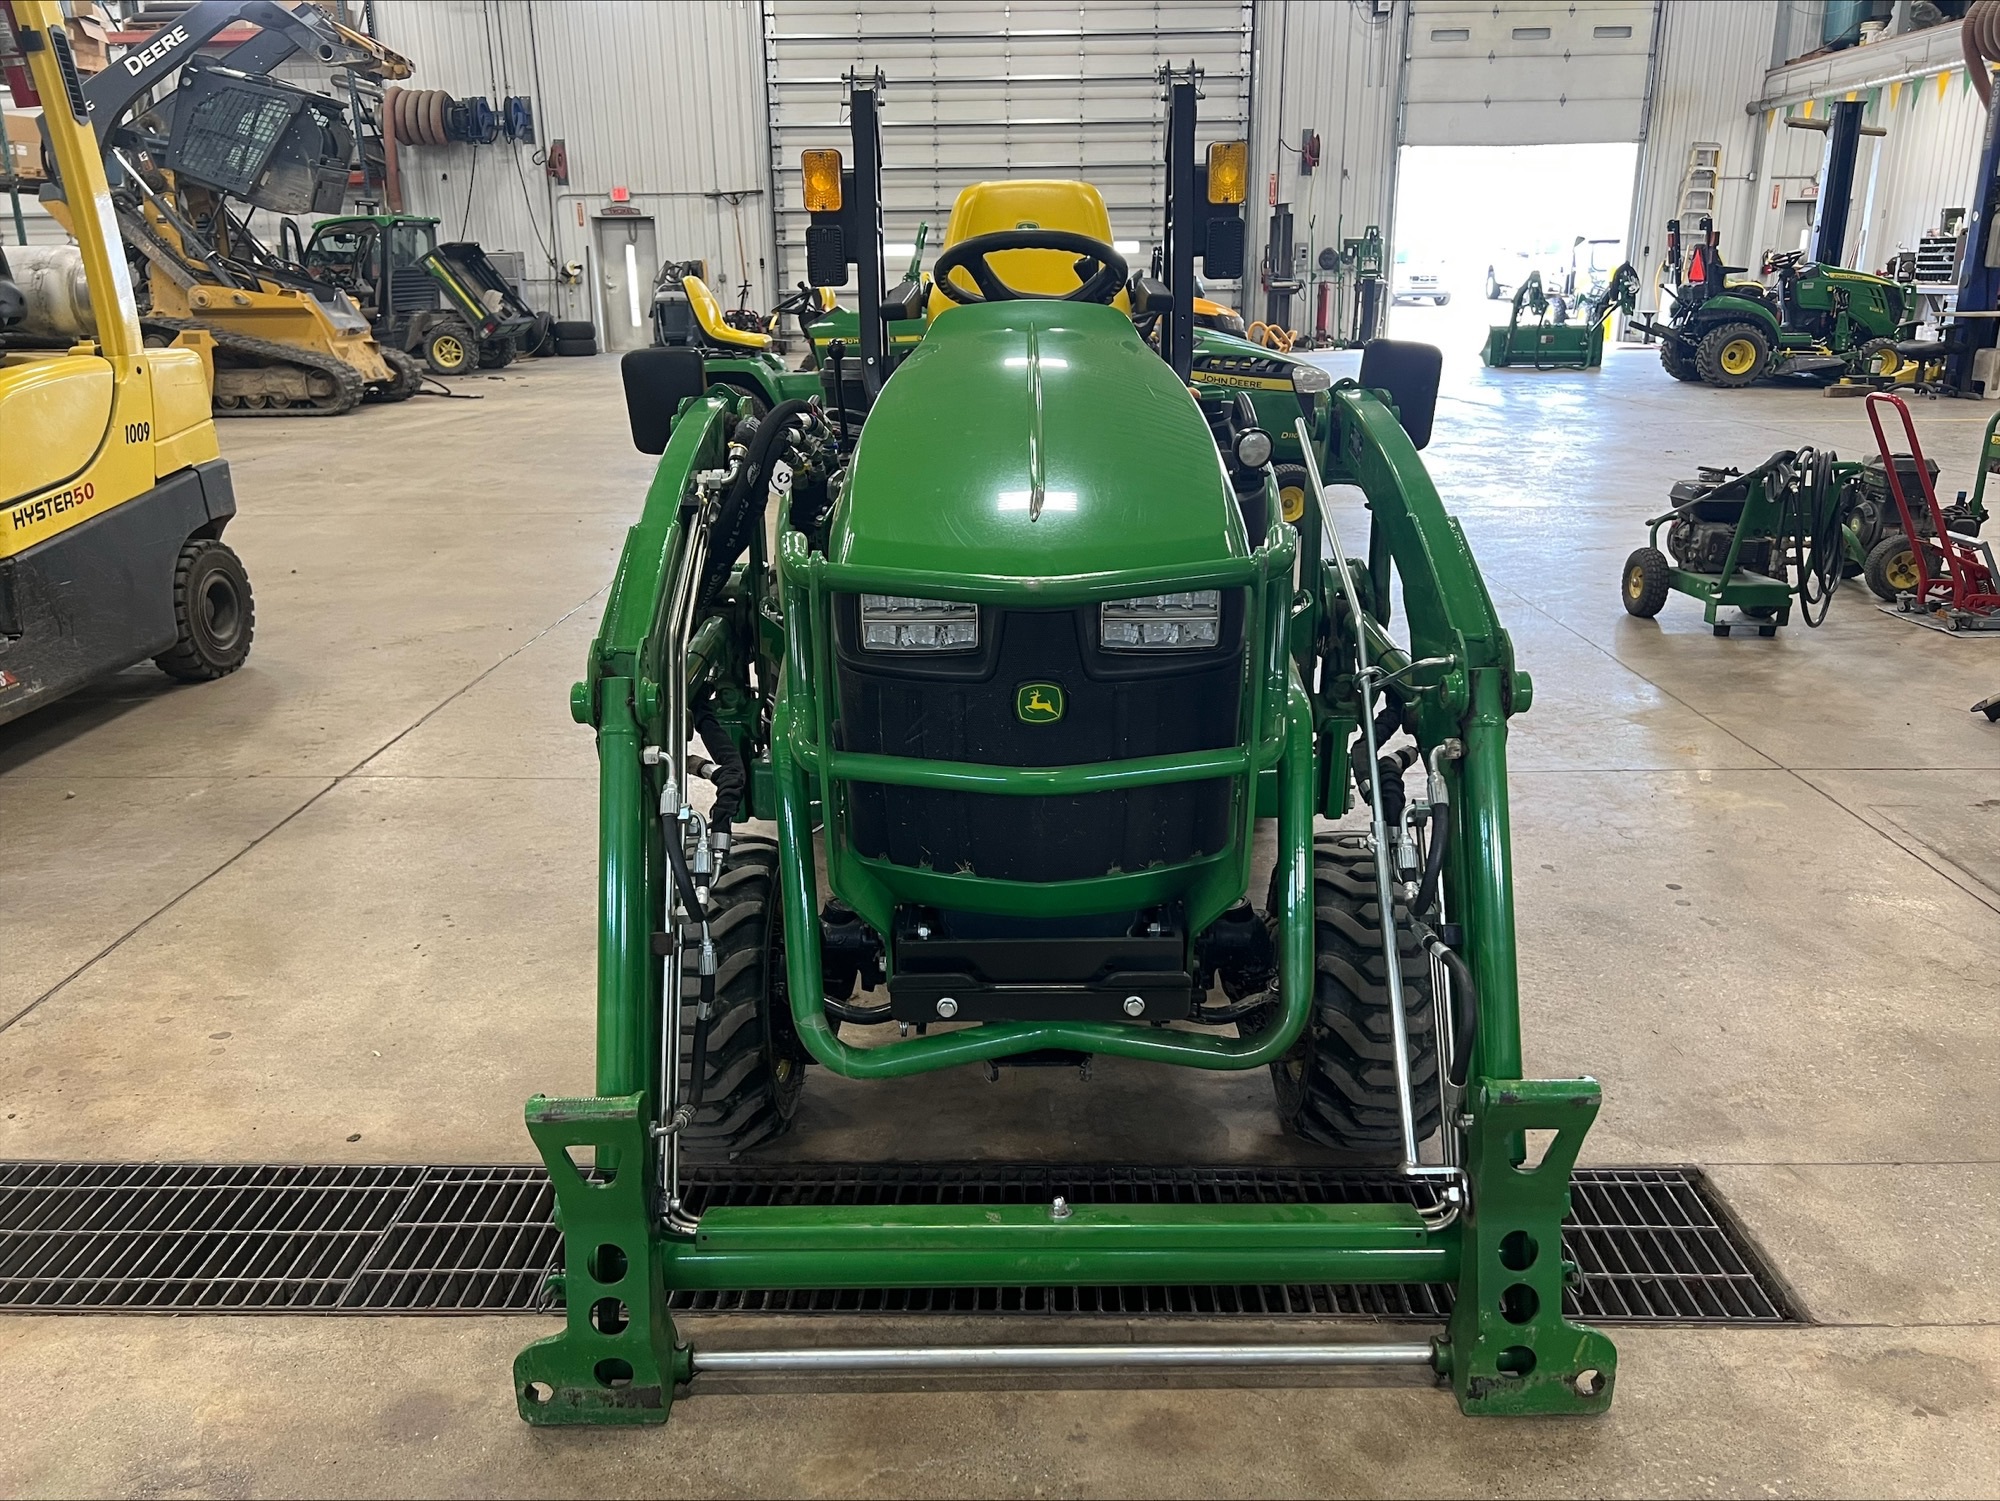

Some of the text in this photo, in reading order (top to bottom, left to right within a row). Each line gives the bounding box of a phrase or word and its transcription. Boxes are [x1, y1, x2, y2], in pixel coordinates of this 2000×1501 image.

[123, 25, 190, 77] DEERE
[1200, 373, 1263, 388] JOHN DEERE
[125, 421, 151, 445] 1009
